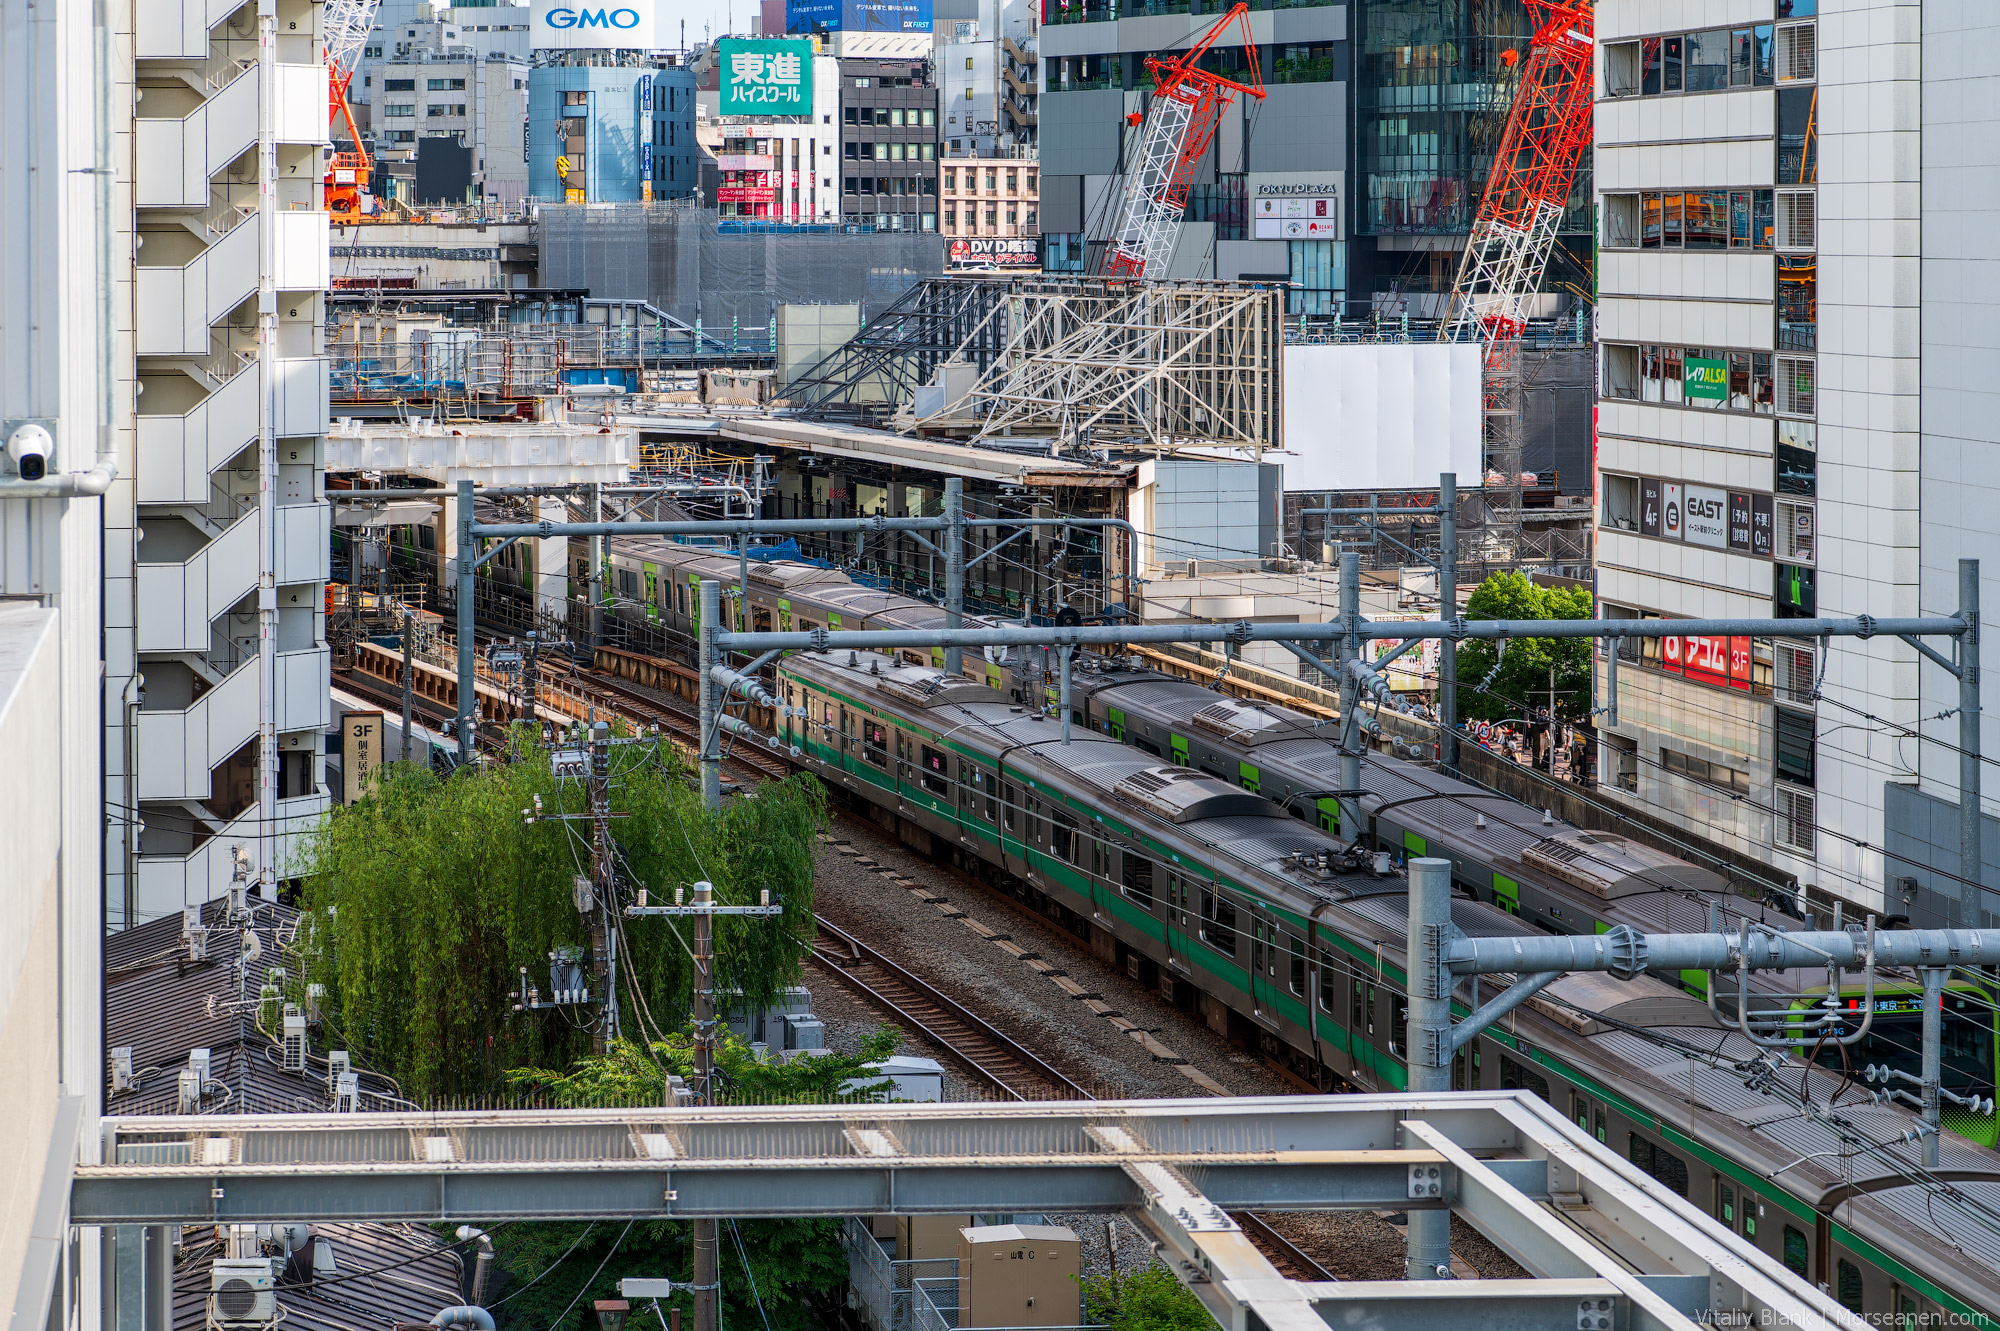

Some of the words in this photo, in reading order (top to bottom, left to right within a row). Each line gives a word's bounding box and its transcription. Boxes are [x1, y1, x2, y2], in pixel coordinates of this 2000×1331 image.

[289, 21, 296, 30] 8
[545, 8, 640, 29] GMO
[730, 52, 801, 85] 東進
[730, 86, 801, 103] ハイスクール
[289, 165, 297, 174] 7
[1256, 184, 1294, 194] TOKYU
[1296, 183, 1336, 194] PLAZA
[289, 308, 297, 317] 6
[290, 451, 298, 460] 5
[1645, 502, 1658, 527] 4F
[1687, 496, 1724, 520] EAST
[290, 595, 298, 603] 4
[1686, 636, 1725, 672] アコム
[1732, 650, 1748, 672] 3F
[352, 724, 373, 738] 3F
[291, 738, 298, 746] 3
